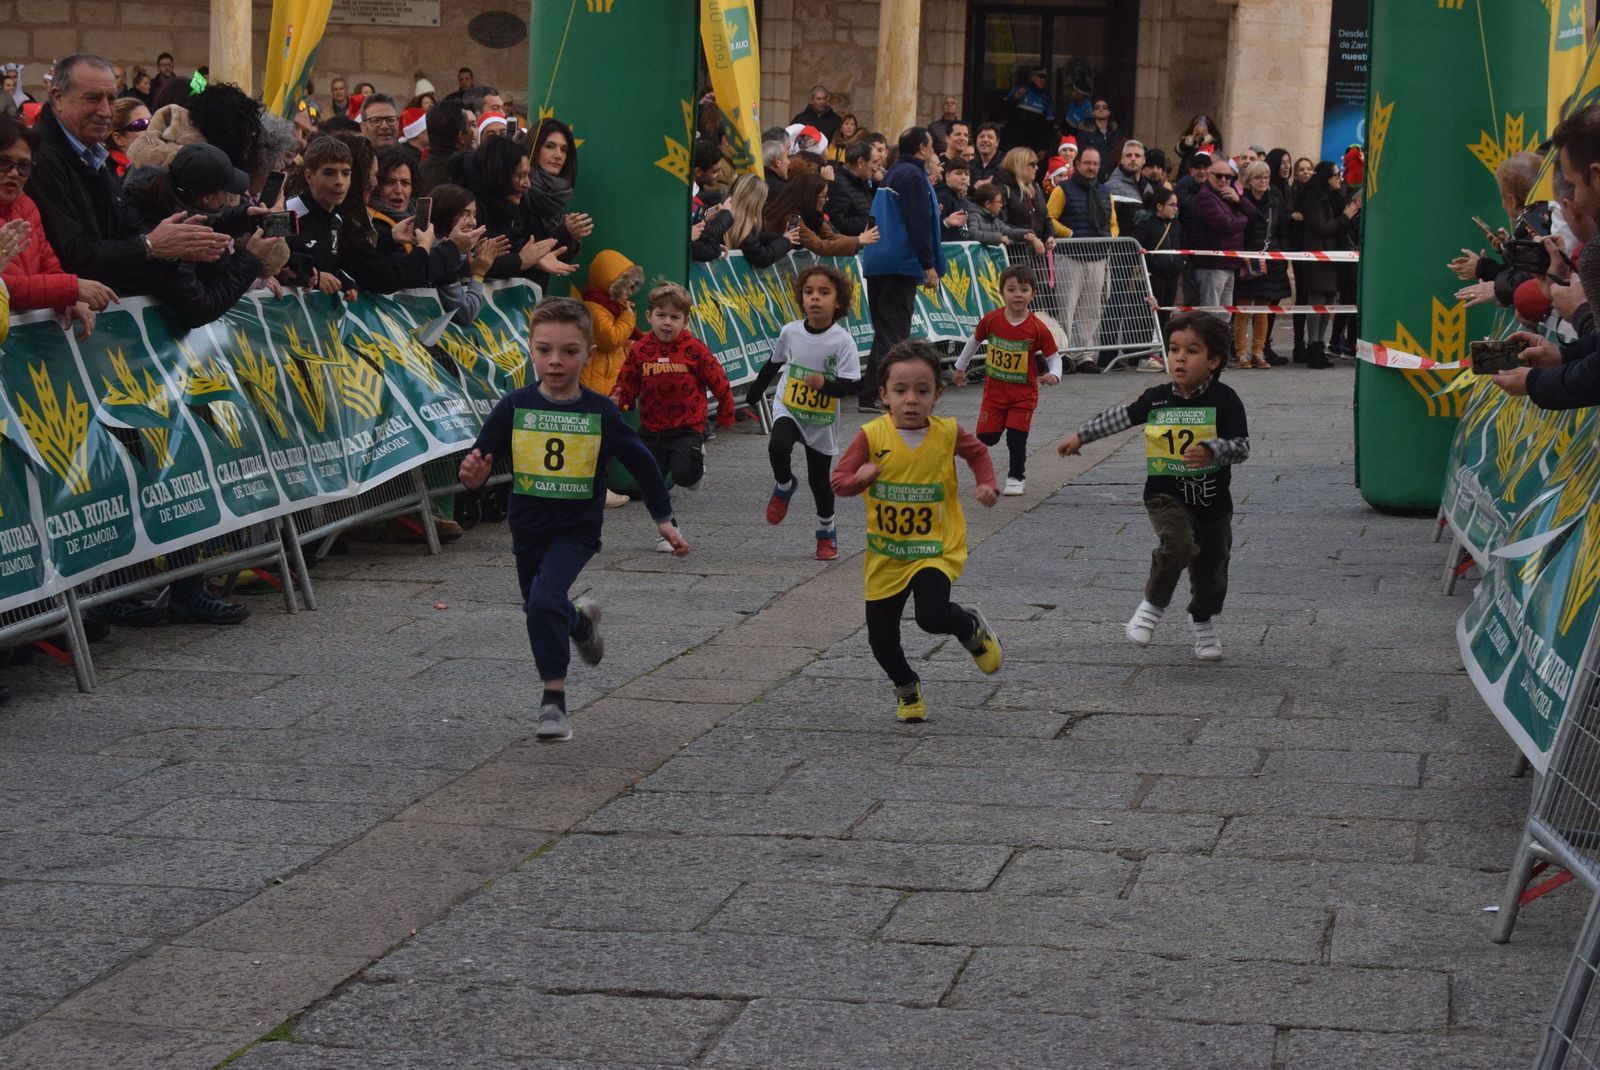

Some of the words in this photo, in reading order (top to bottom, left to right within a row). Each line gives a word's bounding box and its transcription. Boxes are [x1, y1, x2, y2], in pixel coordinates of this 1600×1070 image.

[1338, 29, 1364, 38] Desde
[1340, 40, 1350, 49] de
[991, 348, 1022, 370] 1337
[419, 402, 449, 421] CAJA
[539, 414, 590, 426] FUNDACION
[1166, 410, 1206, 418] FUNDACION
[538, 423, 560, 431] CAJA
[561, 423, 590, 433] RURAL
[371, 435, 410, 461] ZAMORA
[1162, 429, 1195, 455] 12
[544, 438, 565, 471] 8
[217, 461, 242, 485] CAJA
[240, 454, 269, 479] RURAL
[141, 481, 173, 509] CAJA
[171, 470, 211, 496] RURAL
[233, 485, 243, 499] DE
[535, 480, 557, 491] CAJA
[559, 481, 590, 493] RURAL
[888, 486, 936, 495] FUNDACION
[908, 493, 934, 501] RURAL
[45, 509, 83, 539] CAJA
[82, 494, 129, 529] RURAL
[159, 508, 173, 523] DE
[174, 498, 206, 519] ZAMORA
[875, 503, 933, 536] 1333
[0, 523, 38, 555] RURAL
[66, 538, 81, 555] DE
[83, 525, 119, 548] ZAMORA
[907, 546, 938, 554] RURAL
[1, 554, 36, 577] ZAMORA
